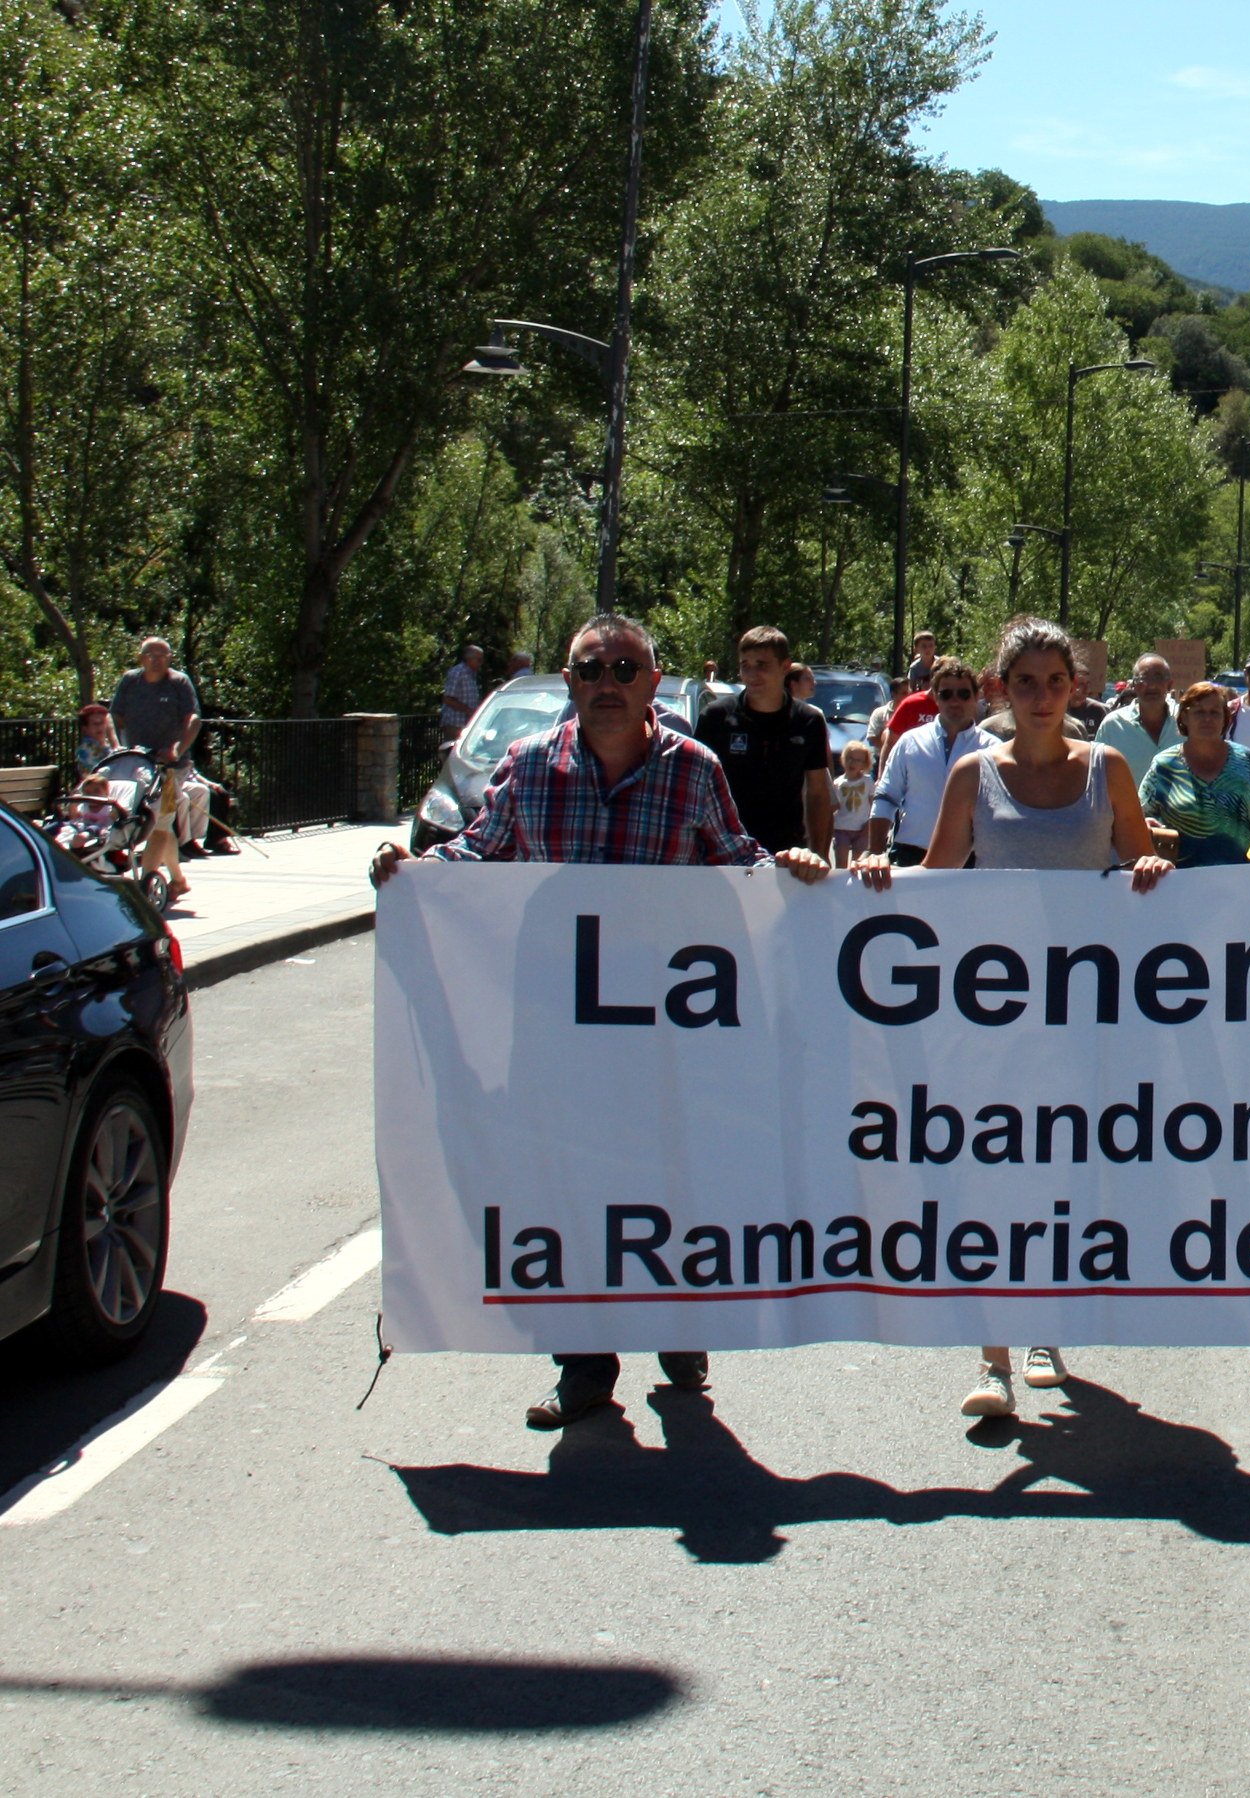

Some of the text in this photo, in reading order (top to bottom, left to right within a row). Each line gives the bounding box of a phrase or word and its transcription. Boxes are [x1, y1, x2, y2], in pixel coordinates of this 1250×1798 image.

[918, 713, 935, 723] xa
[574, 914, 742, 1030] La
[484, 1206, 567, 1291] la
[605, 1200, 1131, 1289] Ramaderia
